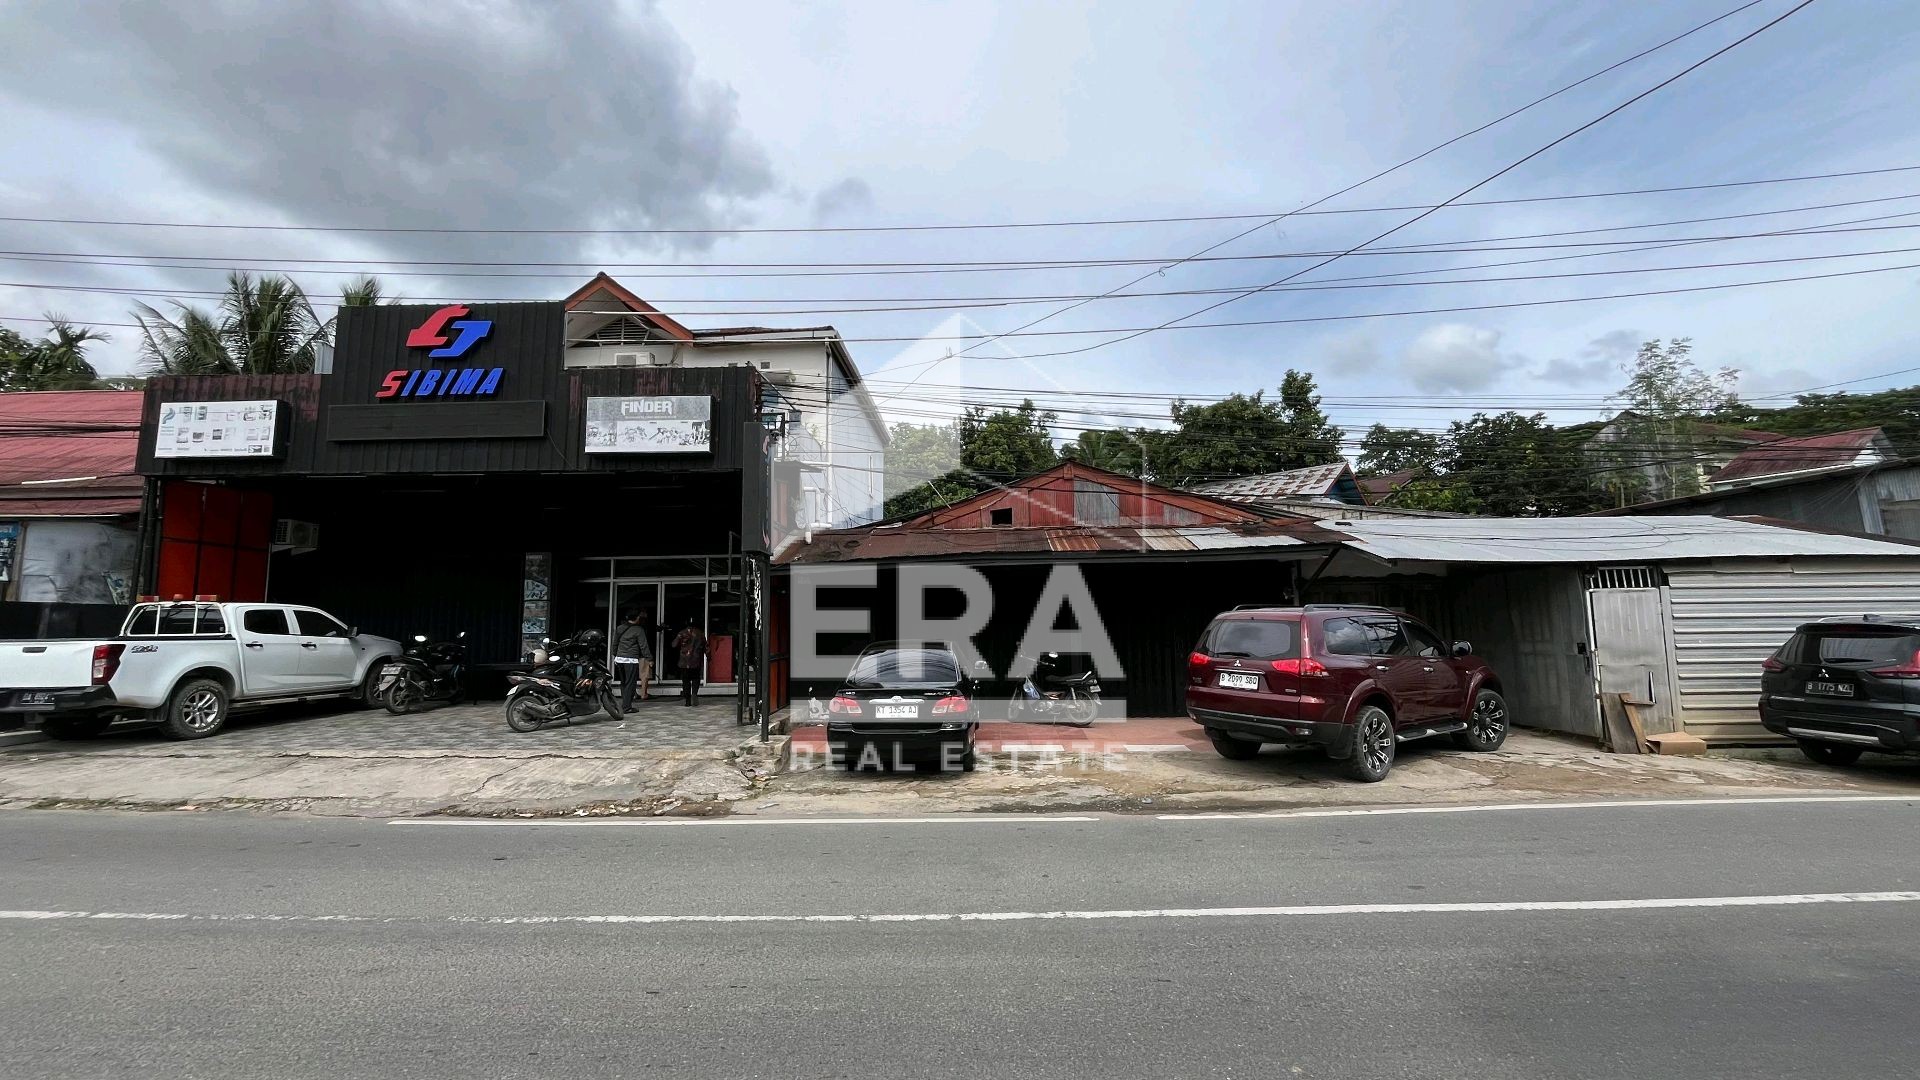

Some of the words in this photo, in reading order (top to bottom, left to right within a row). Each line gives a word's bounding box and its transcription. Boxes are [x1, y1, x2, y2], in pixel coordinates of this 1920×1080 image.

[375, 368, 504, 398] SIBIMA
[621, 399, 673, 415] FINDER
[877, 705, 885, 713] KT
